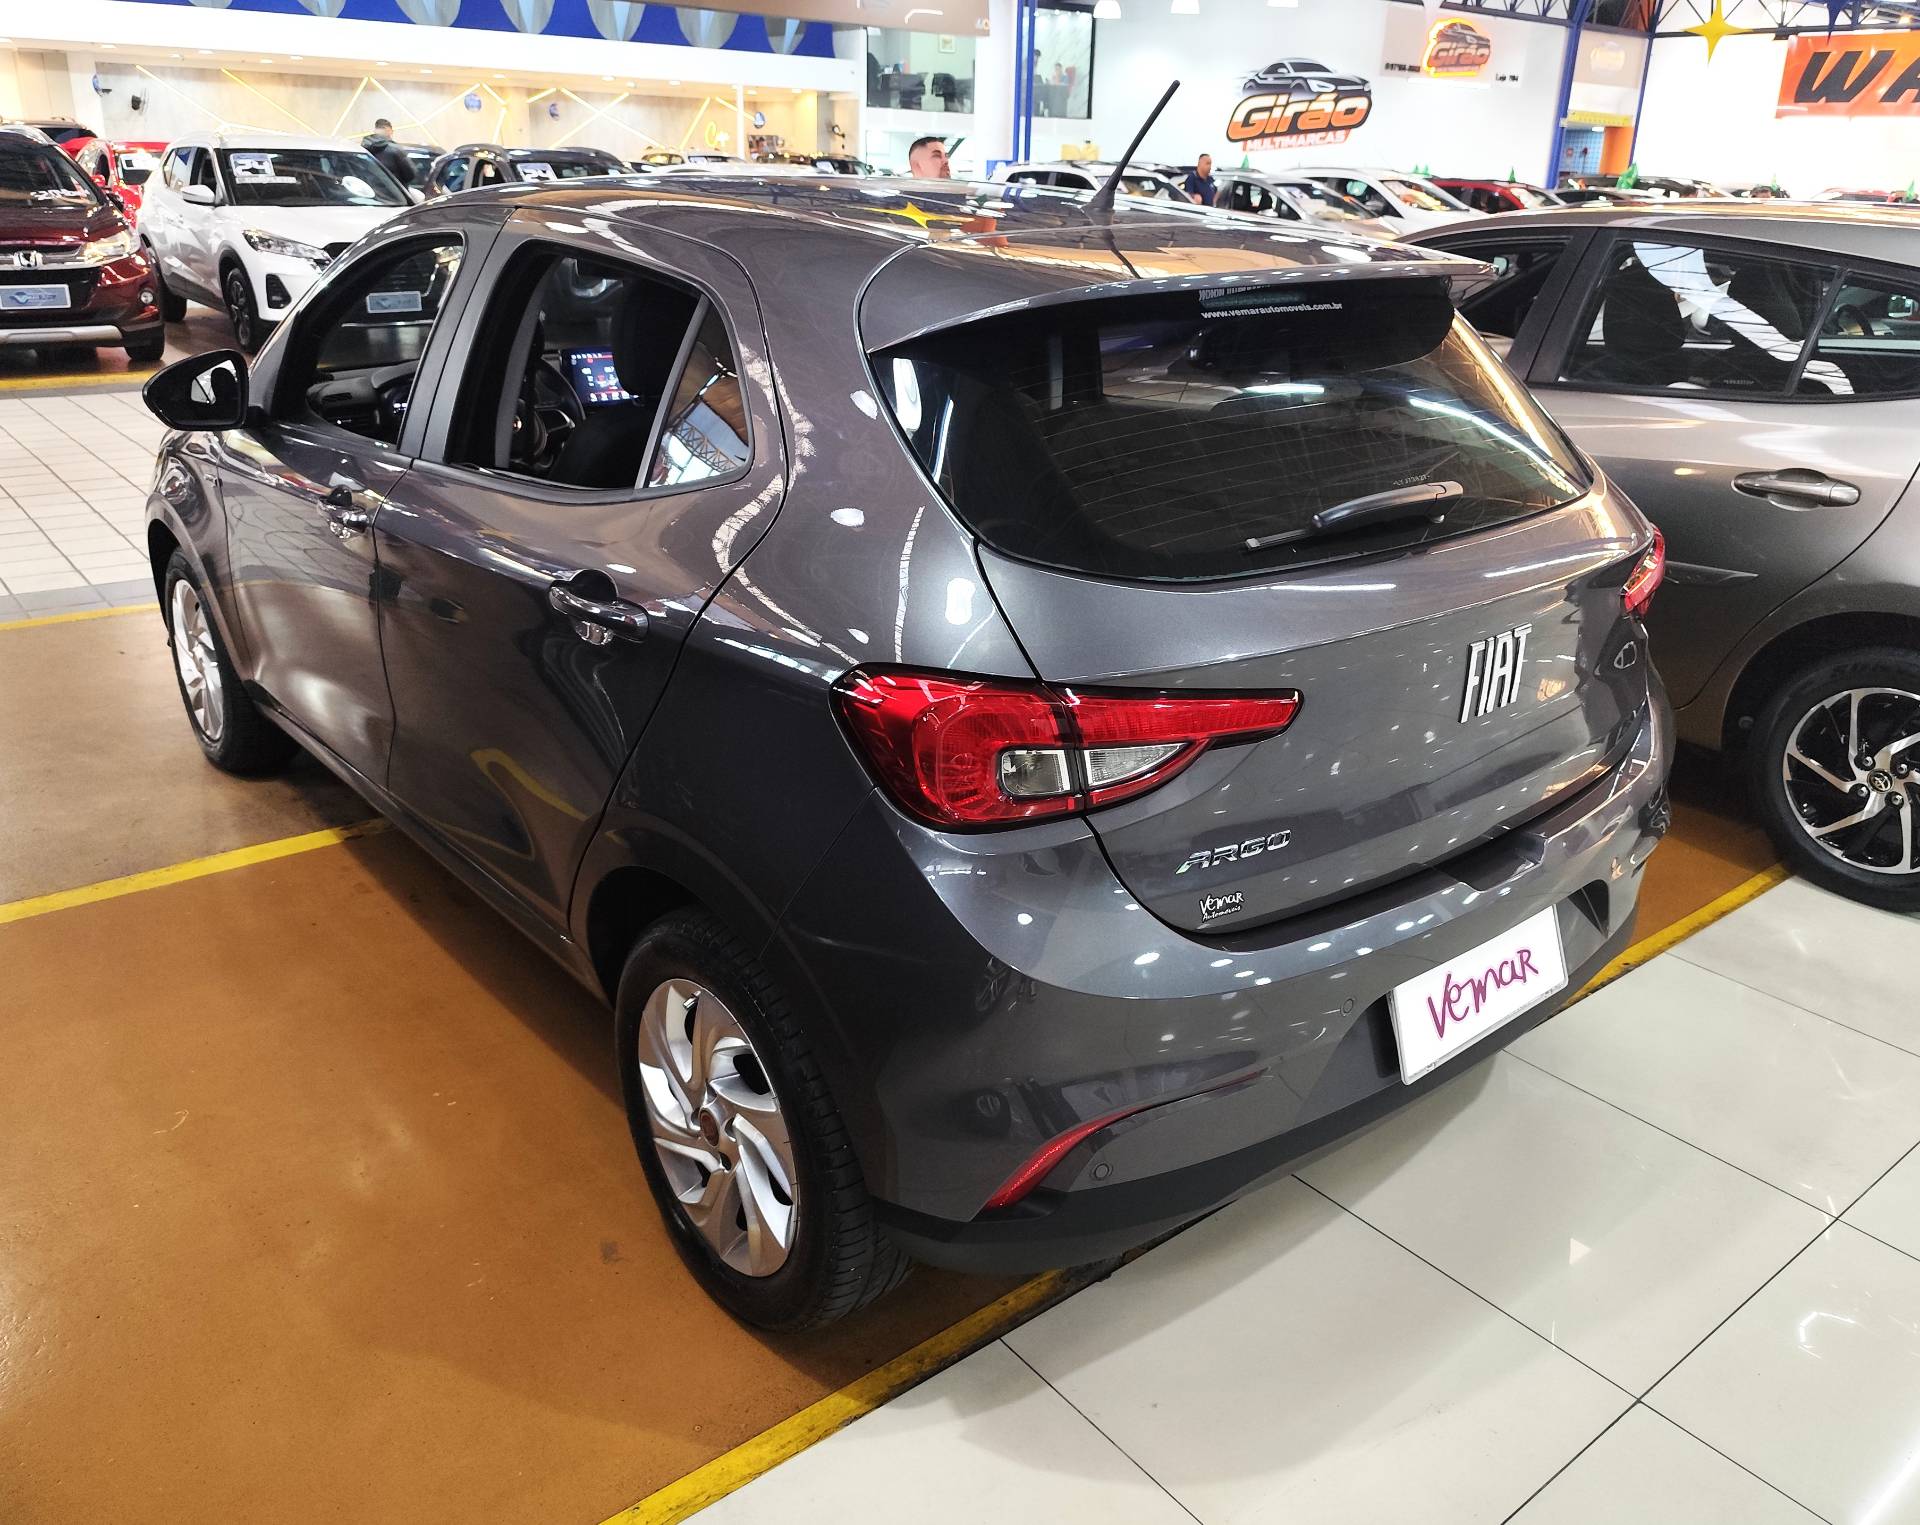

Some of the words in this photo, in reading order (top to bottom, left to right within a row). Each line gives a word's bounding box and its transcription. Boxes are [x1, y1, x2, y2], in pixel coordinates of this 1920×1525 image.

[1246, 131, 1346, 151] MULTIMARCAS
[1201, 302, 1343, 319] www.vemarautomoveis.com.br
[1459, 623, 1532, 724] FIAT
[1175, 829, 1291, 875] ARGO
